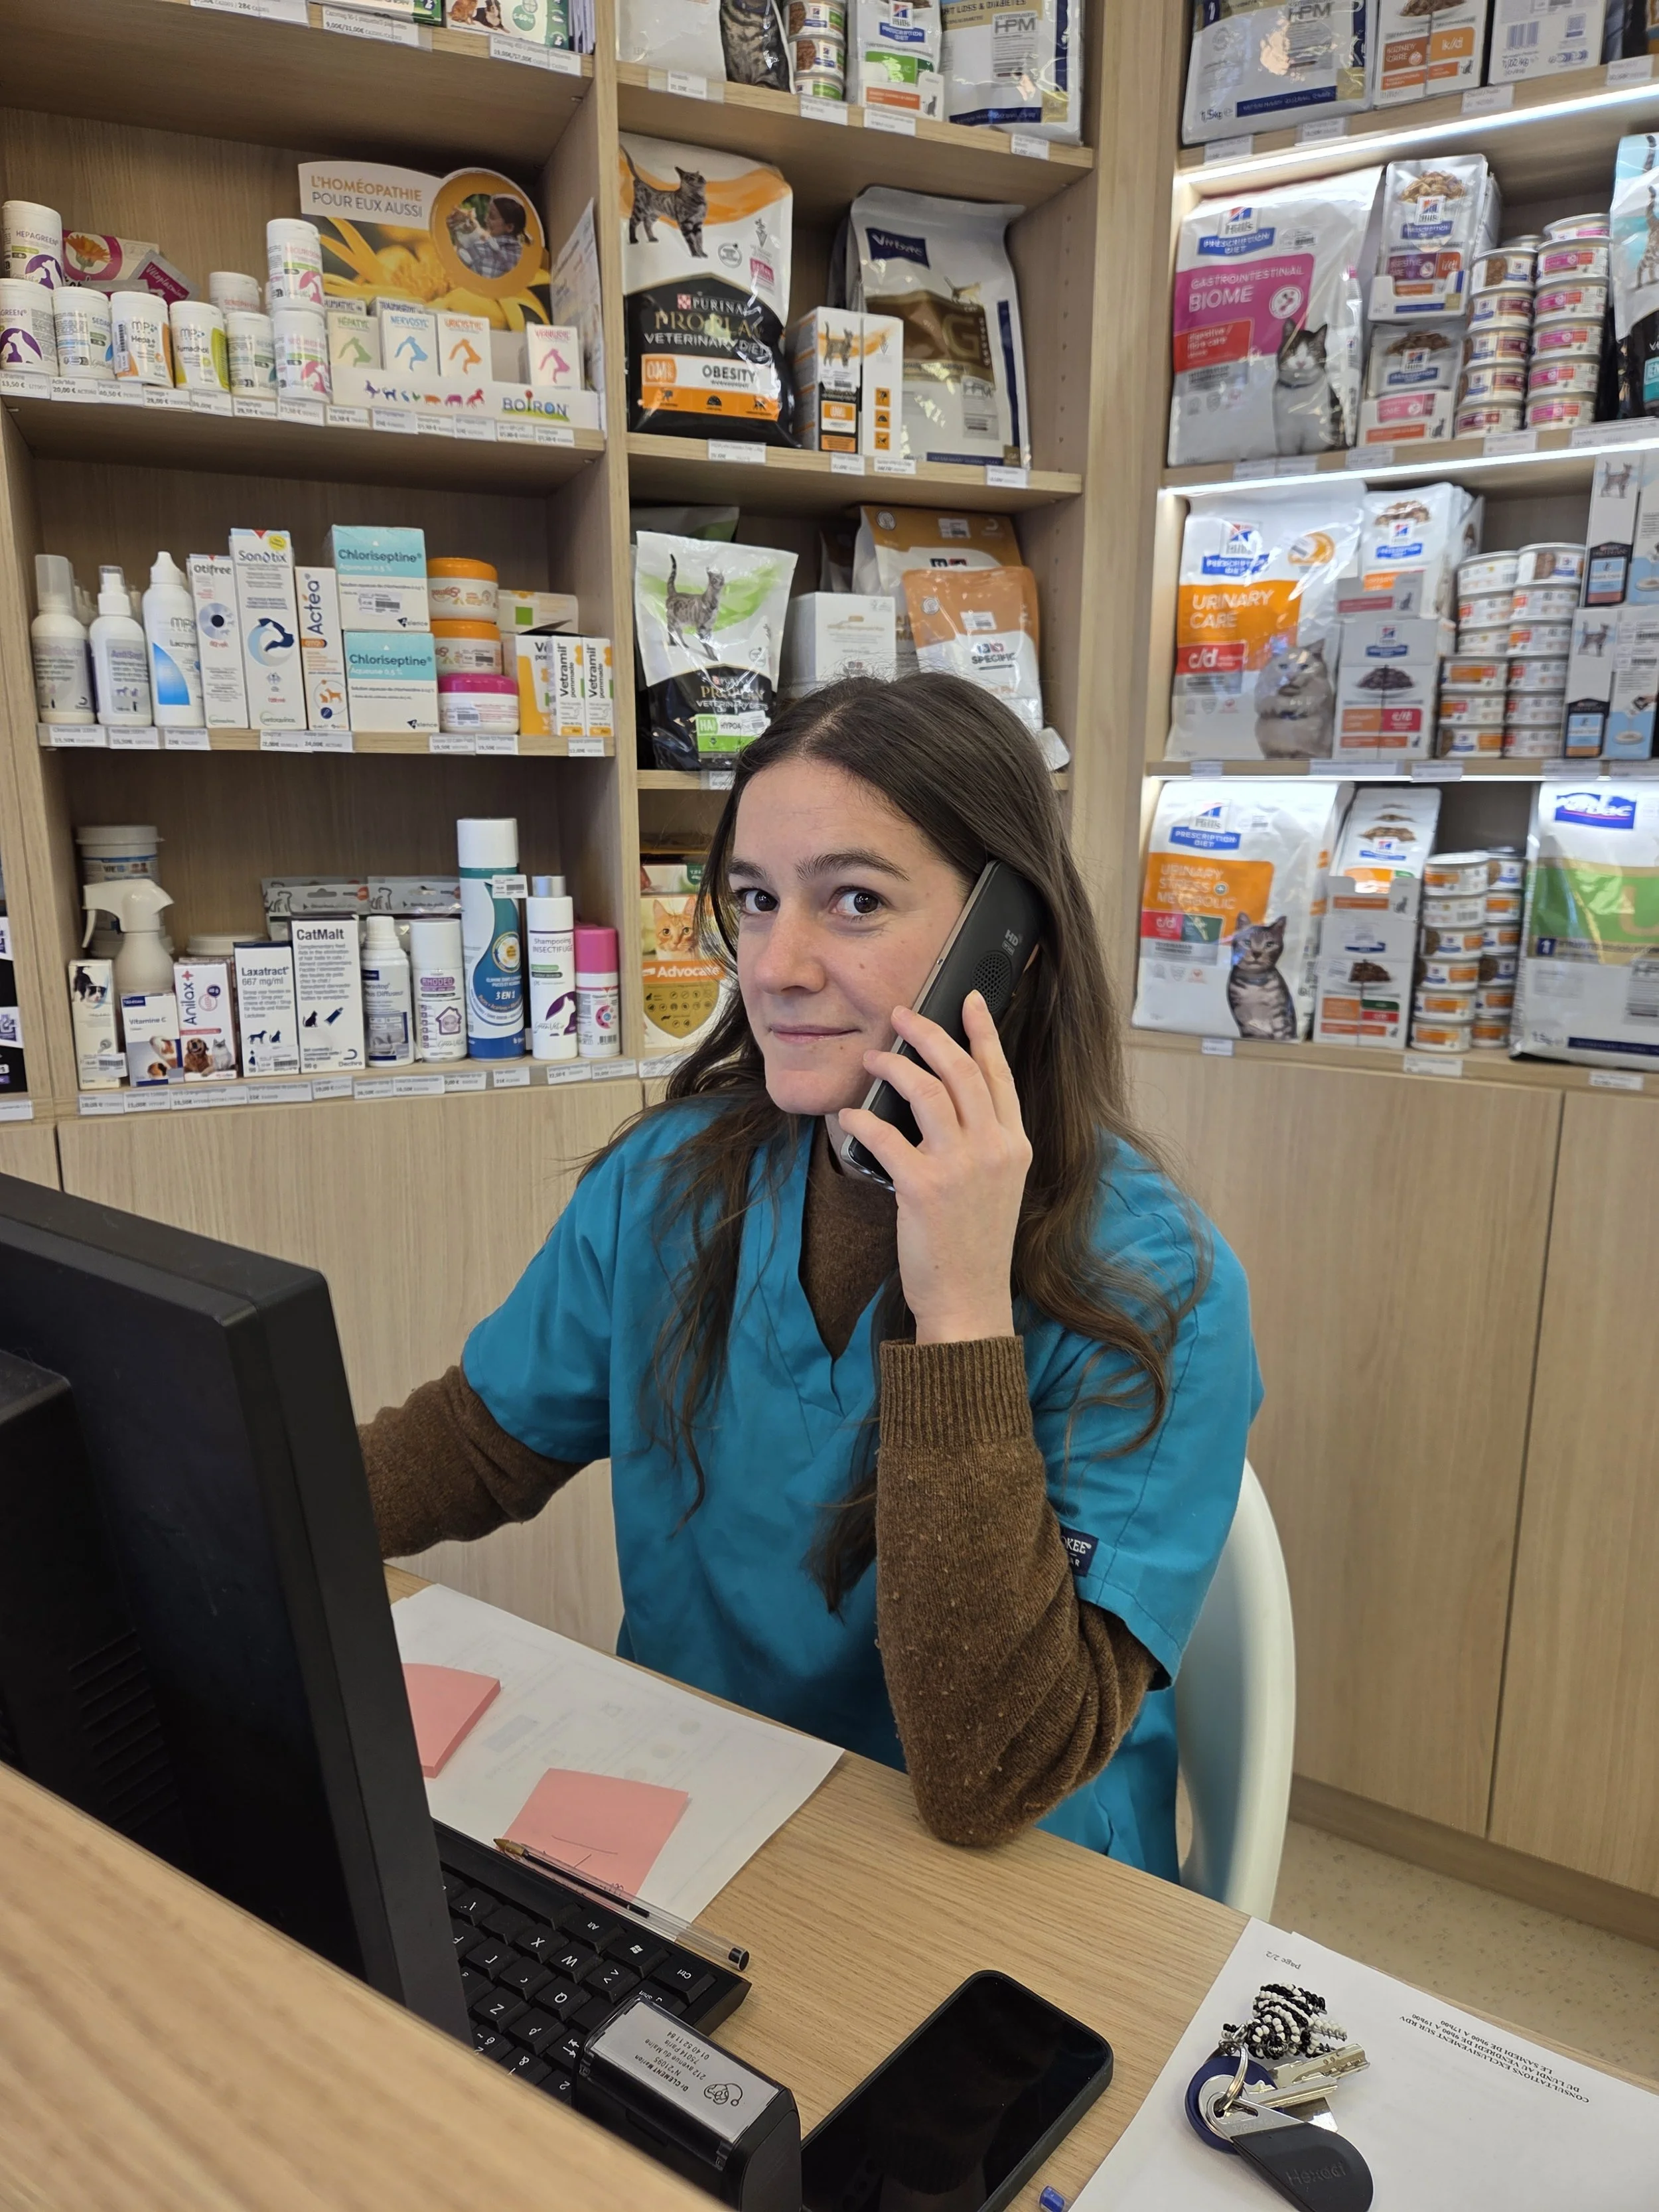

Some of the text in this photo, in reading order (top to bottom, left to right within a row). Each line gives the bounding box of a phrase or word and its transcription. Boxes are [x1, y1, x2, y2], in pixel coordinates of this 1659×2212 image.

[995, 17, 1037, 33] HPM
[311, 175, 422, 202] L'HOMÉOPATHIE
[312, 191, 423, 218] POUR EUX AUSSI
[1203, 232, 1270, 249] PRESCRIPTION
[1190, 265, 1305, 289] GASTROINTESTINAL
[1189, 285, 1254, 313] BIOME
[655, 311, 705, 332] PRO
[702, 364, 755, 384] OBESITY
[501, 390, 567, 417] BOIRON
[193, 564, 232, 577] Otifree
[1192, 589, 1275, 611] URINARY
[1189, 611, 1238, 629] CARE
[972, 653, 1015, 665] SPECIFIC
[559, 644, 568, 698] Vetramil
[587, 646, 597, 699] Vetramil
[1194, 817, 1221, 830] Hill's
[1175, 830, 1238, 844] PRESCRIPTION
[1194, 839, 1215, 848] DIET
[1160, 863, 1225, 880] URINARY
[1158, 877, 1212, 894] STRESS
[1156, 892, 1238, 911] METABOLIC
[297, 928, 344, 940] CatMalt
[1005, 929, 1019, 946] HD
[532, 944, 573, 954] INSECTIFUGE
[656, 964, 721, 980] Advocate
[259, 977, 284, 986] mg/ml
[422, 978, 453, 986] RHODEO
[501, 991, 512, 1000] EN
[129, 1017, 160, 1025] Vitamine
[530, 1937, 545, 1949] X
[561, 1955, 578, 1967] W
[1265, 1950, 1302, 1970] page 2/2
[677, 1968, 692, 1979] Ctrl
[554, 1992, 568, 2004] Q
[490, 2004, 504, 2015] Z
[1411, 2014, 1433, 2027] 19h00
[1440, 2020, 1462, 2033] 17h00
[1442, 2028, 1460, 2040] 9h00
[1461, 2037, 1474, 2046] DE
[1471, 2034, 1489, 2046] 9h00
[644, 2039, 664, 2054] Maine
[664, 2039, 700, 2065] 75014 Paris
[1490, 2043, 1502, 2053] DE
[634, 2055, 654, 2070] Marion
[700, 2052, 710, 2061] 01
[1399, 2016, 1589, 2103] CONSULTATIONS EXCLUSIVEMENT SUR RDV
[1474, 2042, 1520, 2068] VENDREDI
[1504, 2050, 1540, 2069] SAMEDI
[671, 2055, 694, 2071] avenue
[1540, 2065, 1553, 2075] LE
[652, 2067, 682, 2087] CLEMENT
[692, 2070, 707, 2081] 212
[1536, 2070, 1565, 2087] LUNDI
[1566, 2084, 1580, 2093] DU
